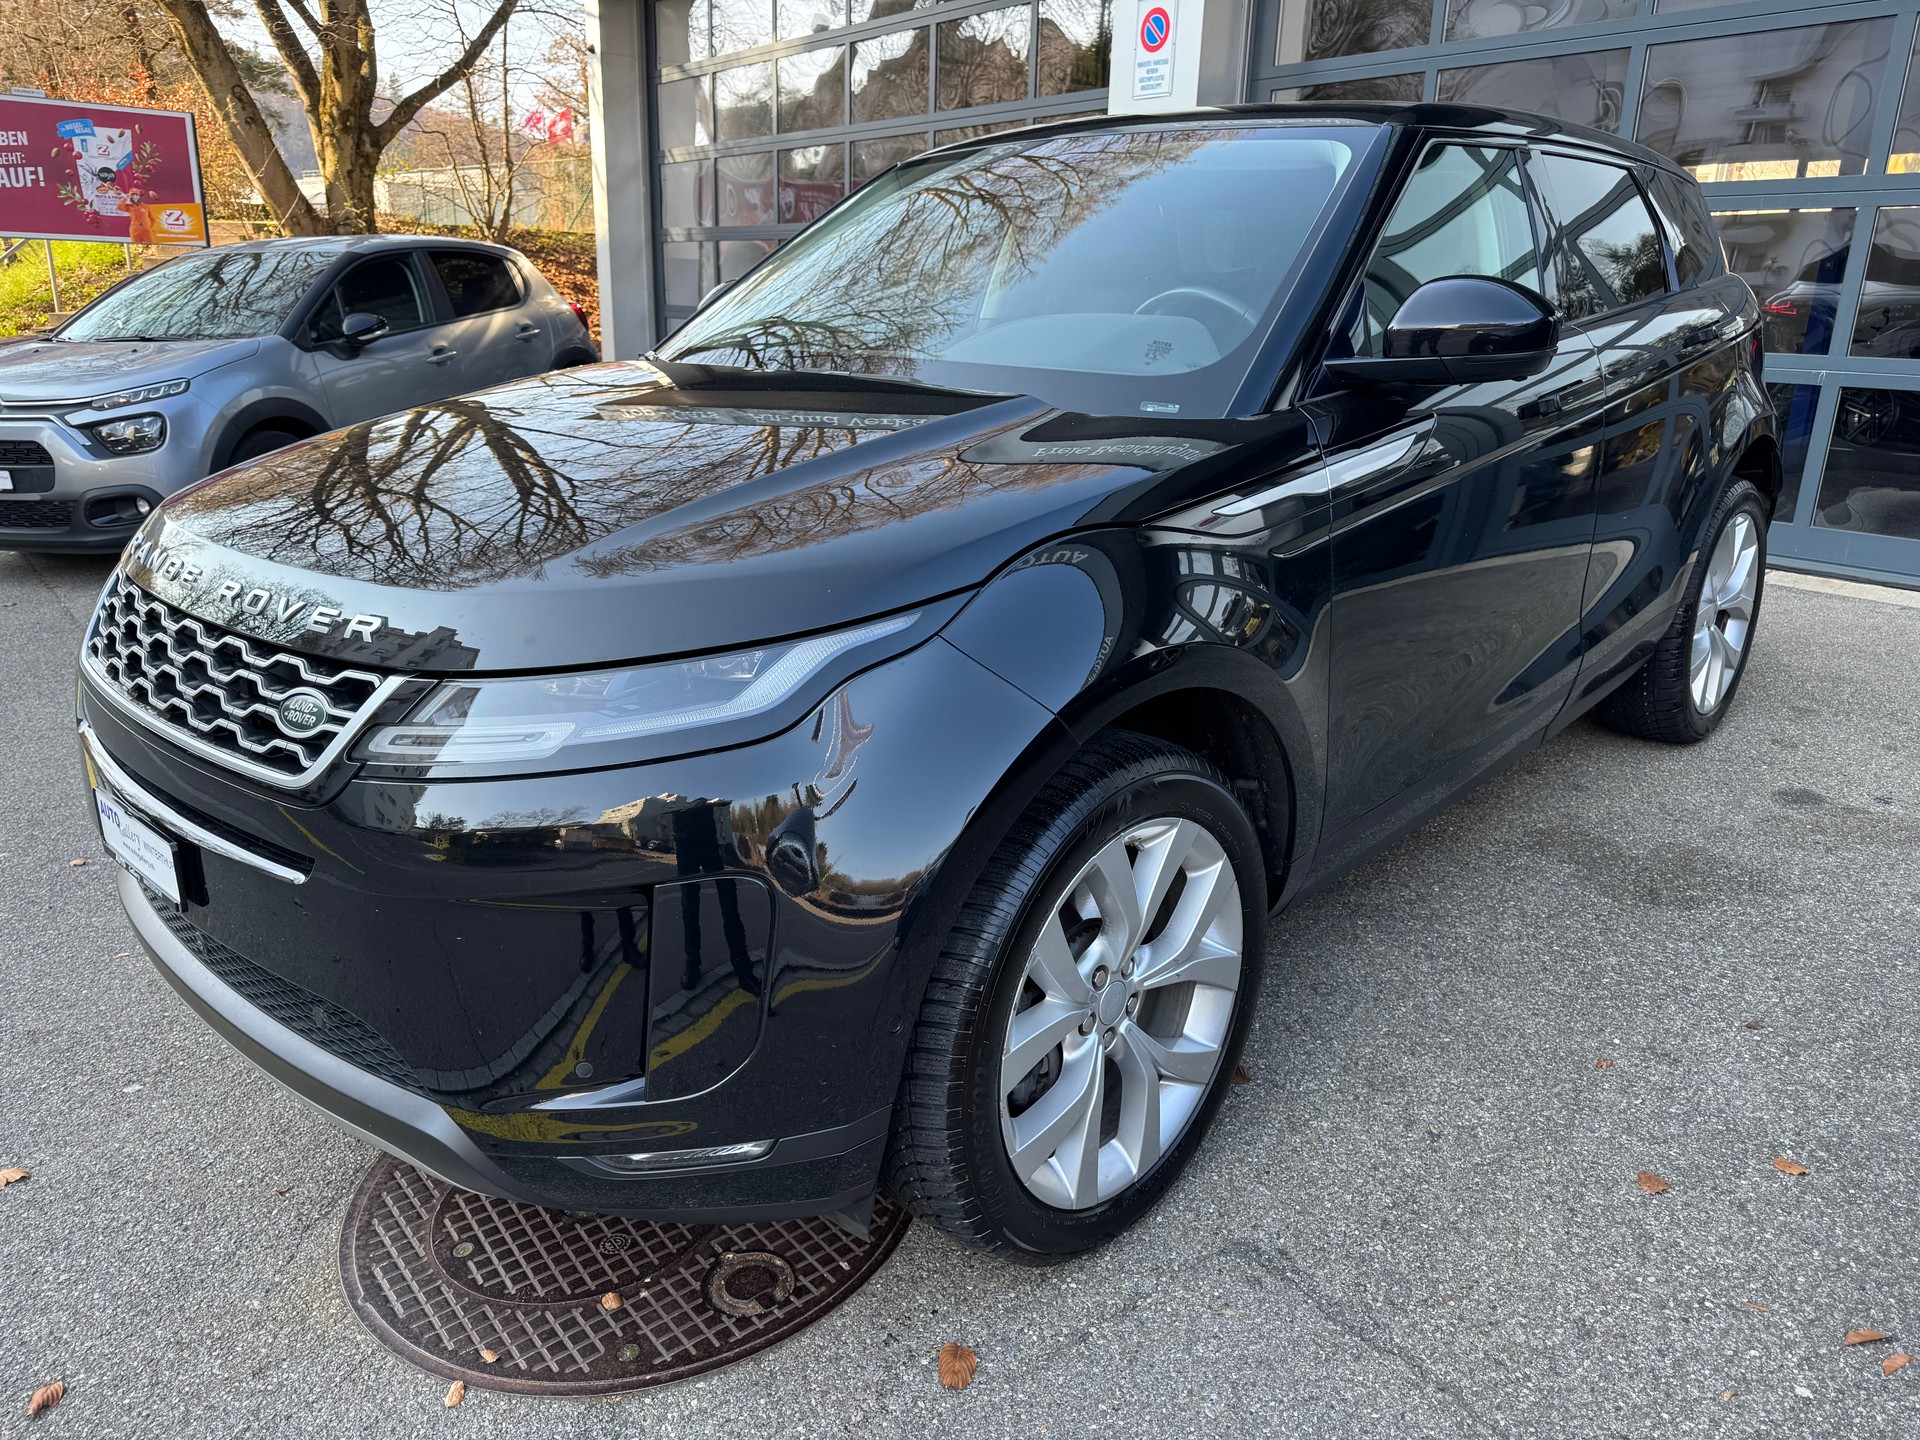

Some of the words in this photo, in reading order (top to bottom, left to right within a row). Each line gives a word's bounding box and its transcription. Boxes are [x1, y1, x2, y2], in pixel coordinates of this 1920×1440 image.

[0, 131, 28, 145] BEN
[0, 166, 46, 188] AUF!
[164, 209, 185, 226] Z
[131, 531, 203, 591] RANGE
[218, 579, 384, 644] ROVER
[289, 698, 315, 713] LAND
[286, 709, 317, 727] ROVER
[100, 799, 121, 829] AUTO
